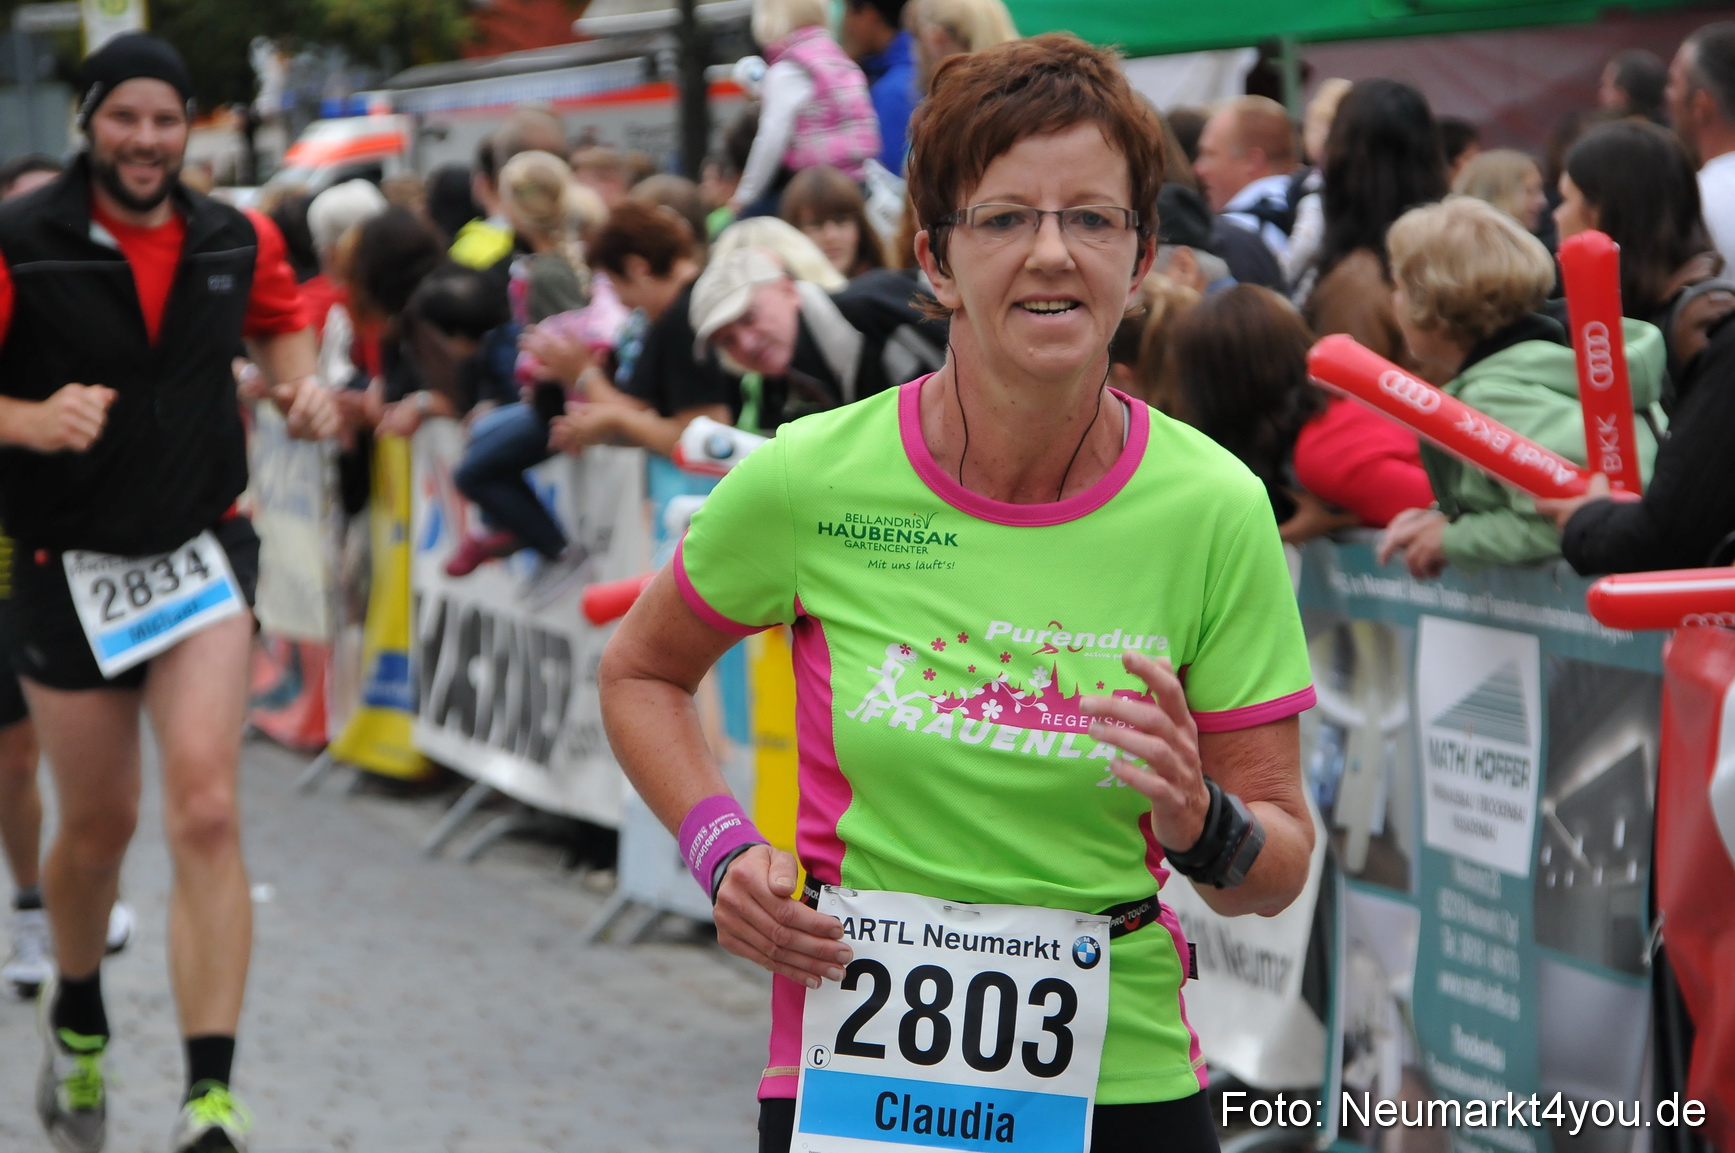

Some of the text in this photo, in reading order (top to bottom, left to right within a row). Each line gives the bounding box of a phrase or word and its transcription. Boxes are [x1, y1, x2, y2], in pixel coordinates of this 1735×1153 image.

[1454, 411, 1578, 486] Audi BKK
[1596, 412, 1623, 474] BKK
[818, 521, 959, 547] HAUBENSAK
[845, 512, 922, 529] BELLANDRIS
[844, 539, 929, 555] GARTENCENTER
[867, 559, 887, 570] Mit
[891, 562, 911, 570] uns
[91, 548, 211, 623] 2834
[984, 620, 1169, 651] Purendure
[1109, 902, 1151, 929] PRO TOUCH
[832, 914, 1061, 961] ARTL Neumarkt
[833, 957, 1079, 1079] 2803
[813, 1048, 824, 1066] C
[874, 1090, 1016, 1144] Claudia
